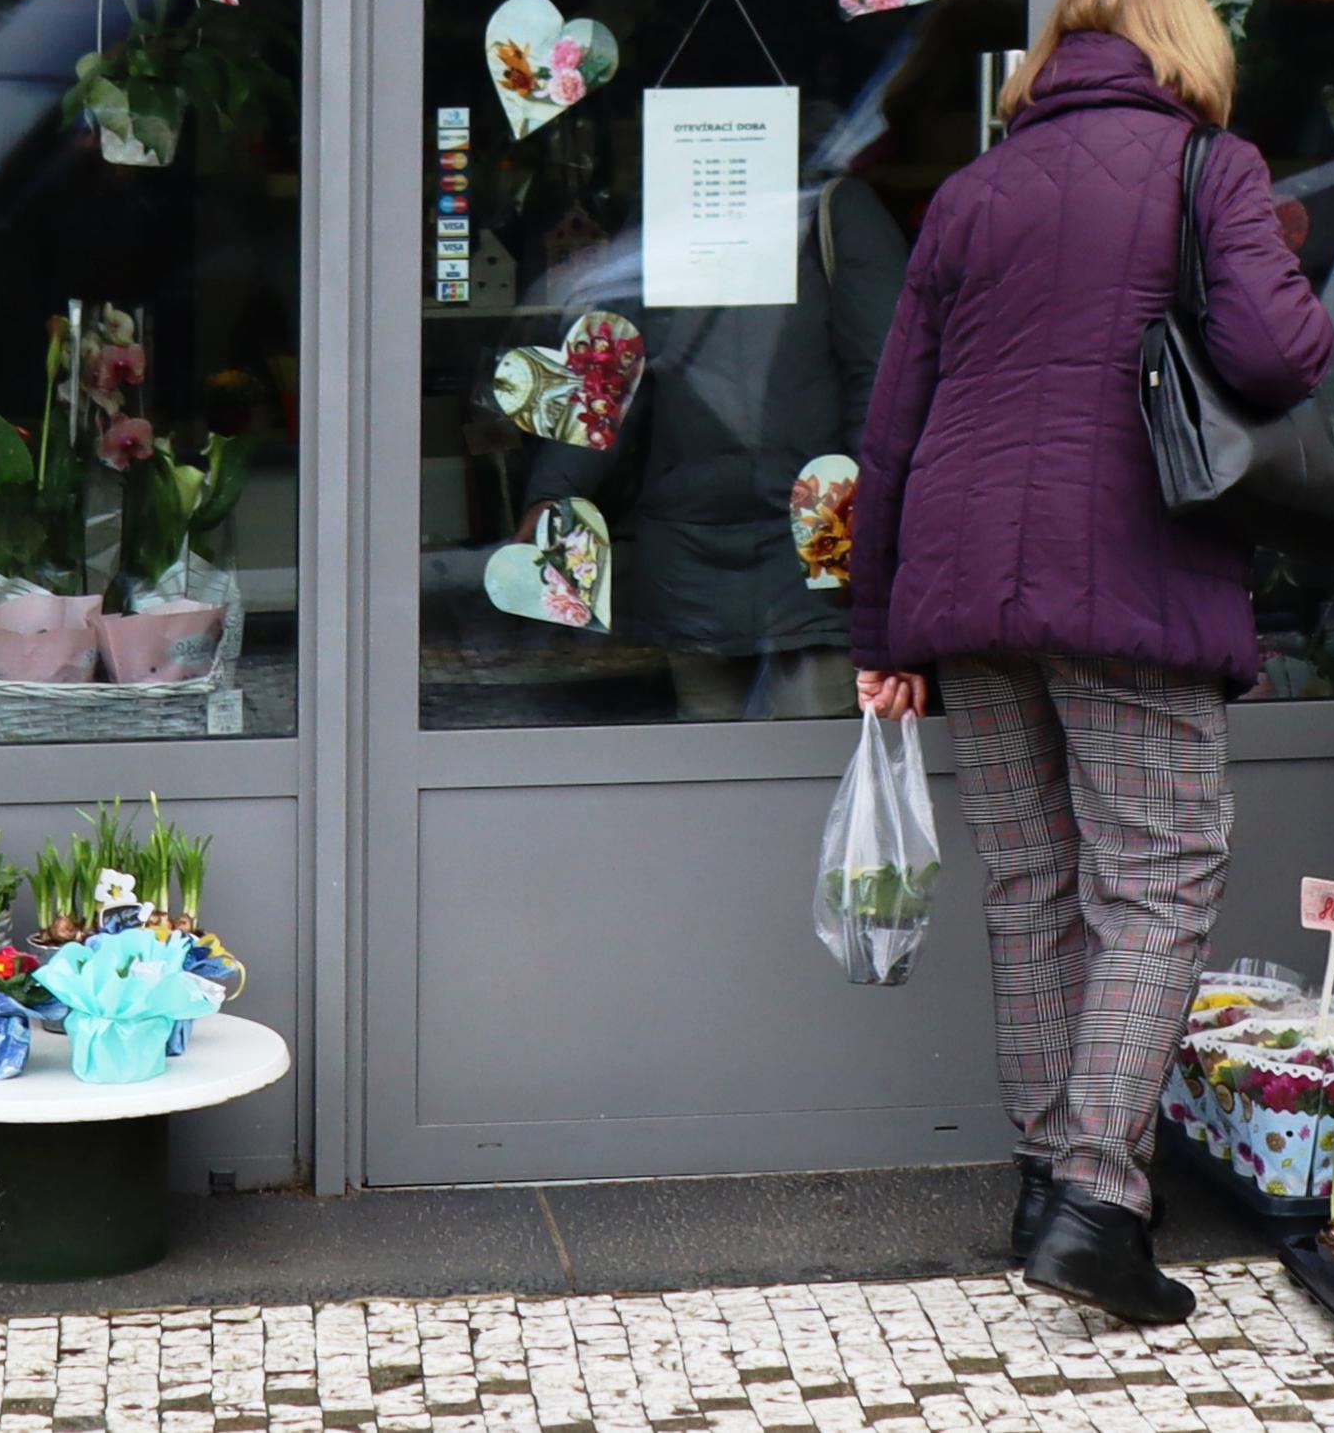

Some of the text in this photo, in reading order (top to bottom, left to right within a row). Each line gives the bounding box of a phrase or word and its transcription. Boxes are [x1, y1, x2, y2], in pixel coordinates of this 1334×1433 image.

[674, 121, 767, 132] OTEVÍRACÍ DOBA
[442, 221, 465, 230] VISA
[442, 243, 464, 252] VISA
